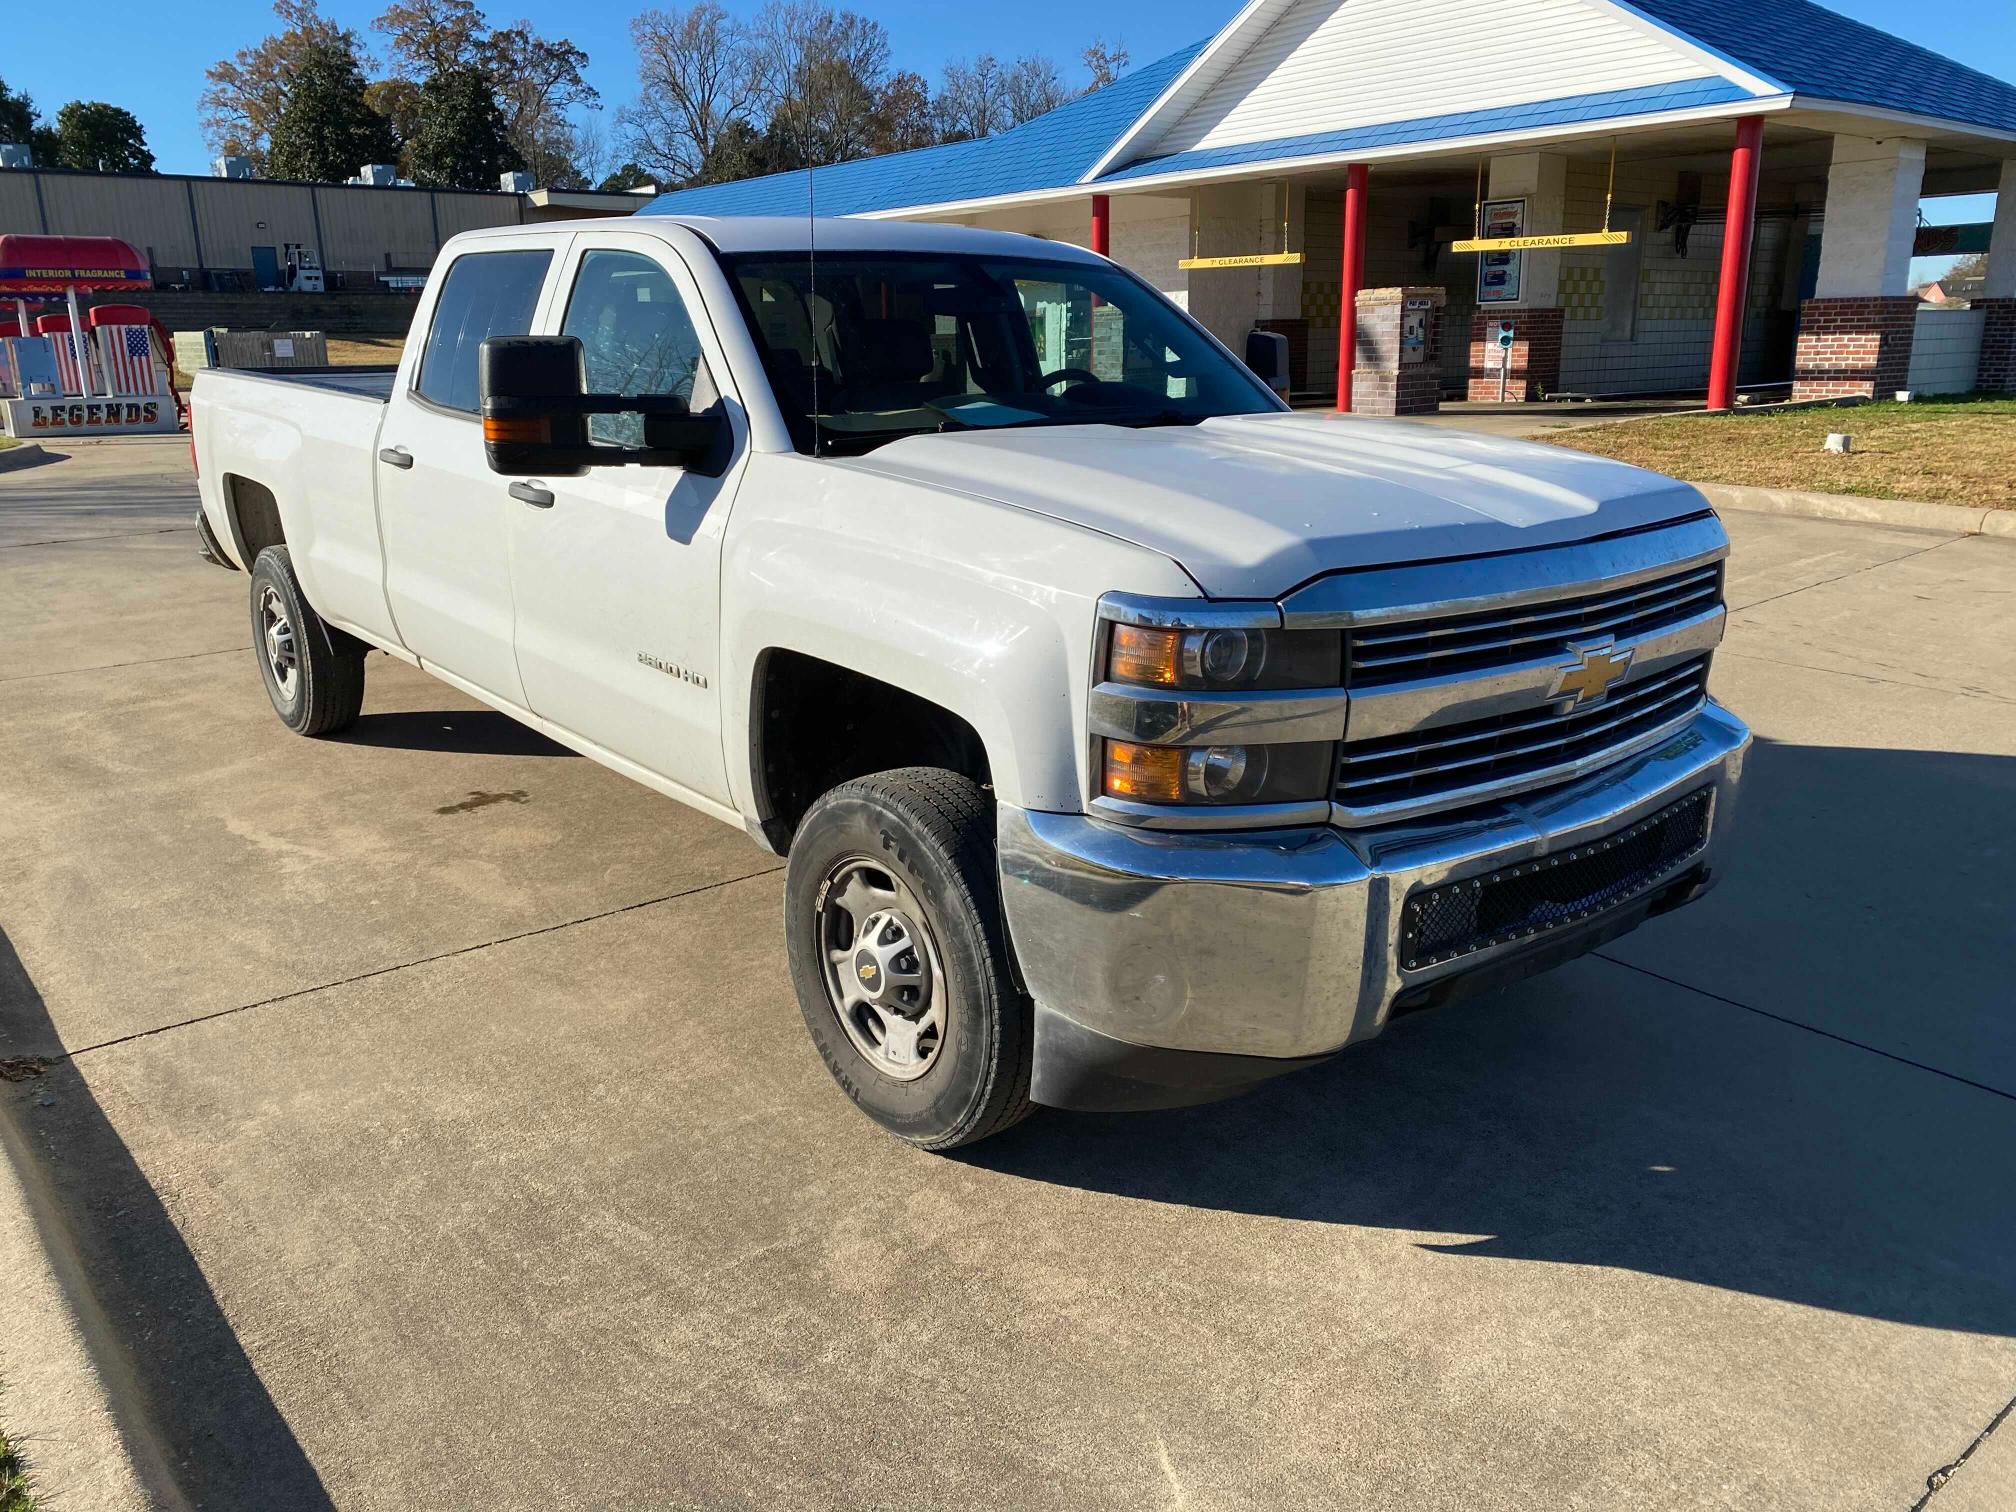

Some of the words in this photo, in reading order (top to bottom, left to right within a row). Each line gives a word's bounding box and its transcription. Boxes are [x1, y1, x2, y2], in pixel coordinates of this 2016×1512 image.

[1497, 240, 1506, 248] 7'
[1509, 237, 1575, 247] CLEARANCE
[1218, 256, 1265, 266] CLEARANCE
[25, 269, 72, 278] INTERIOR
[74, 269, 126, 278] FRAGRANCE
[32, 402, 159, 429] LEGENDS
[683, 669, 708, 689] HD
